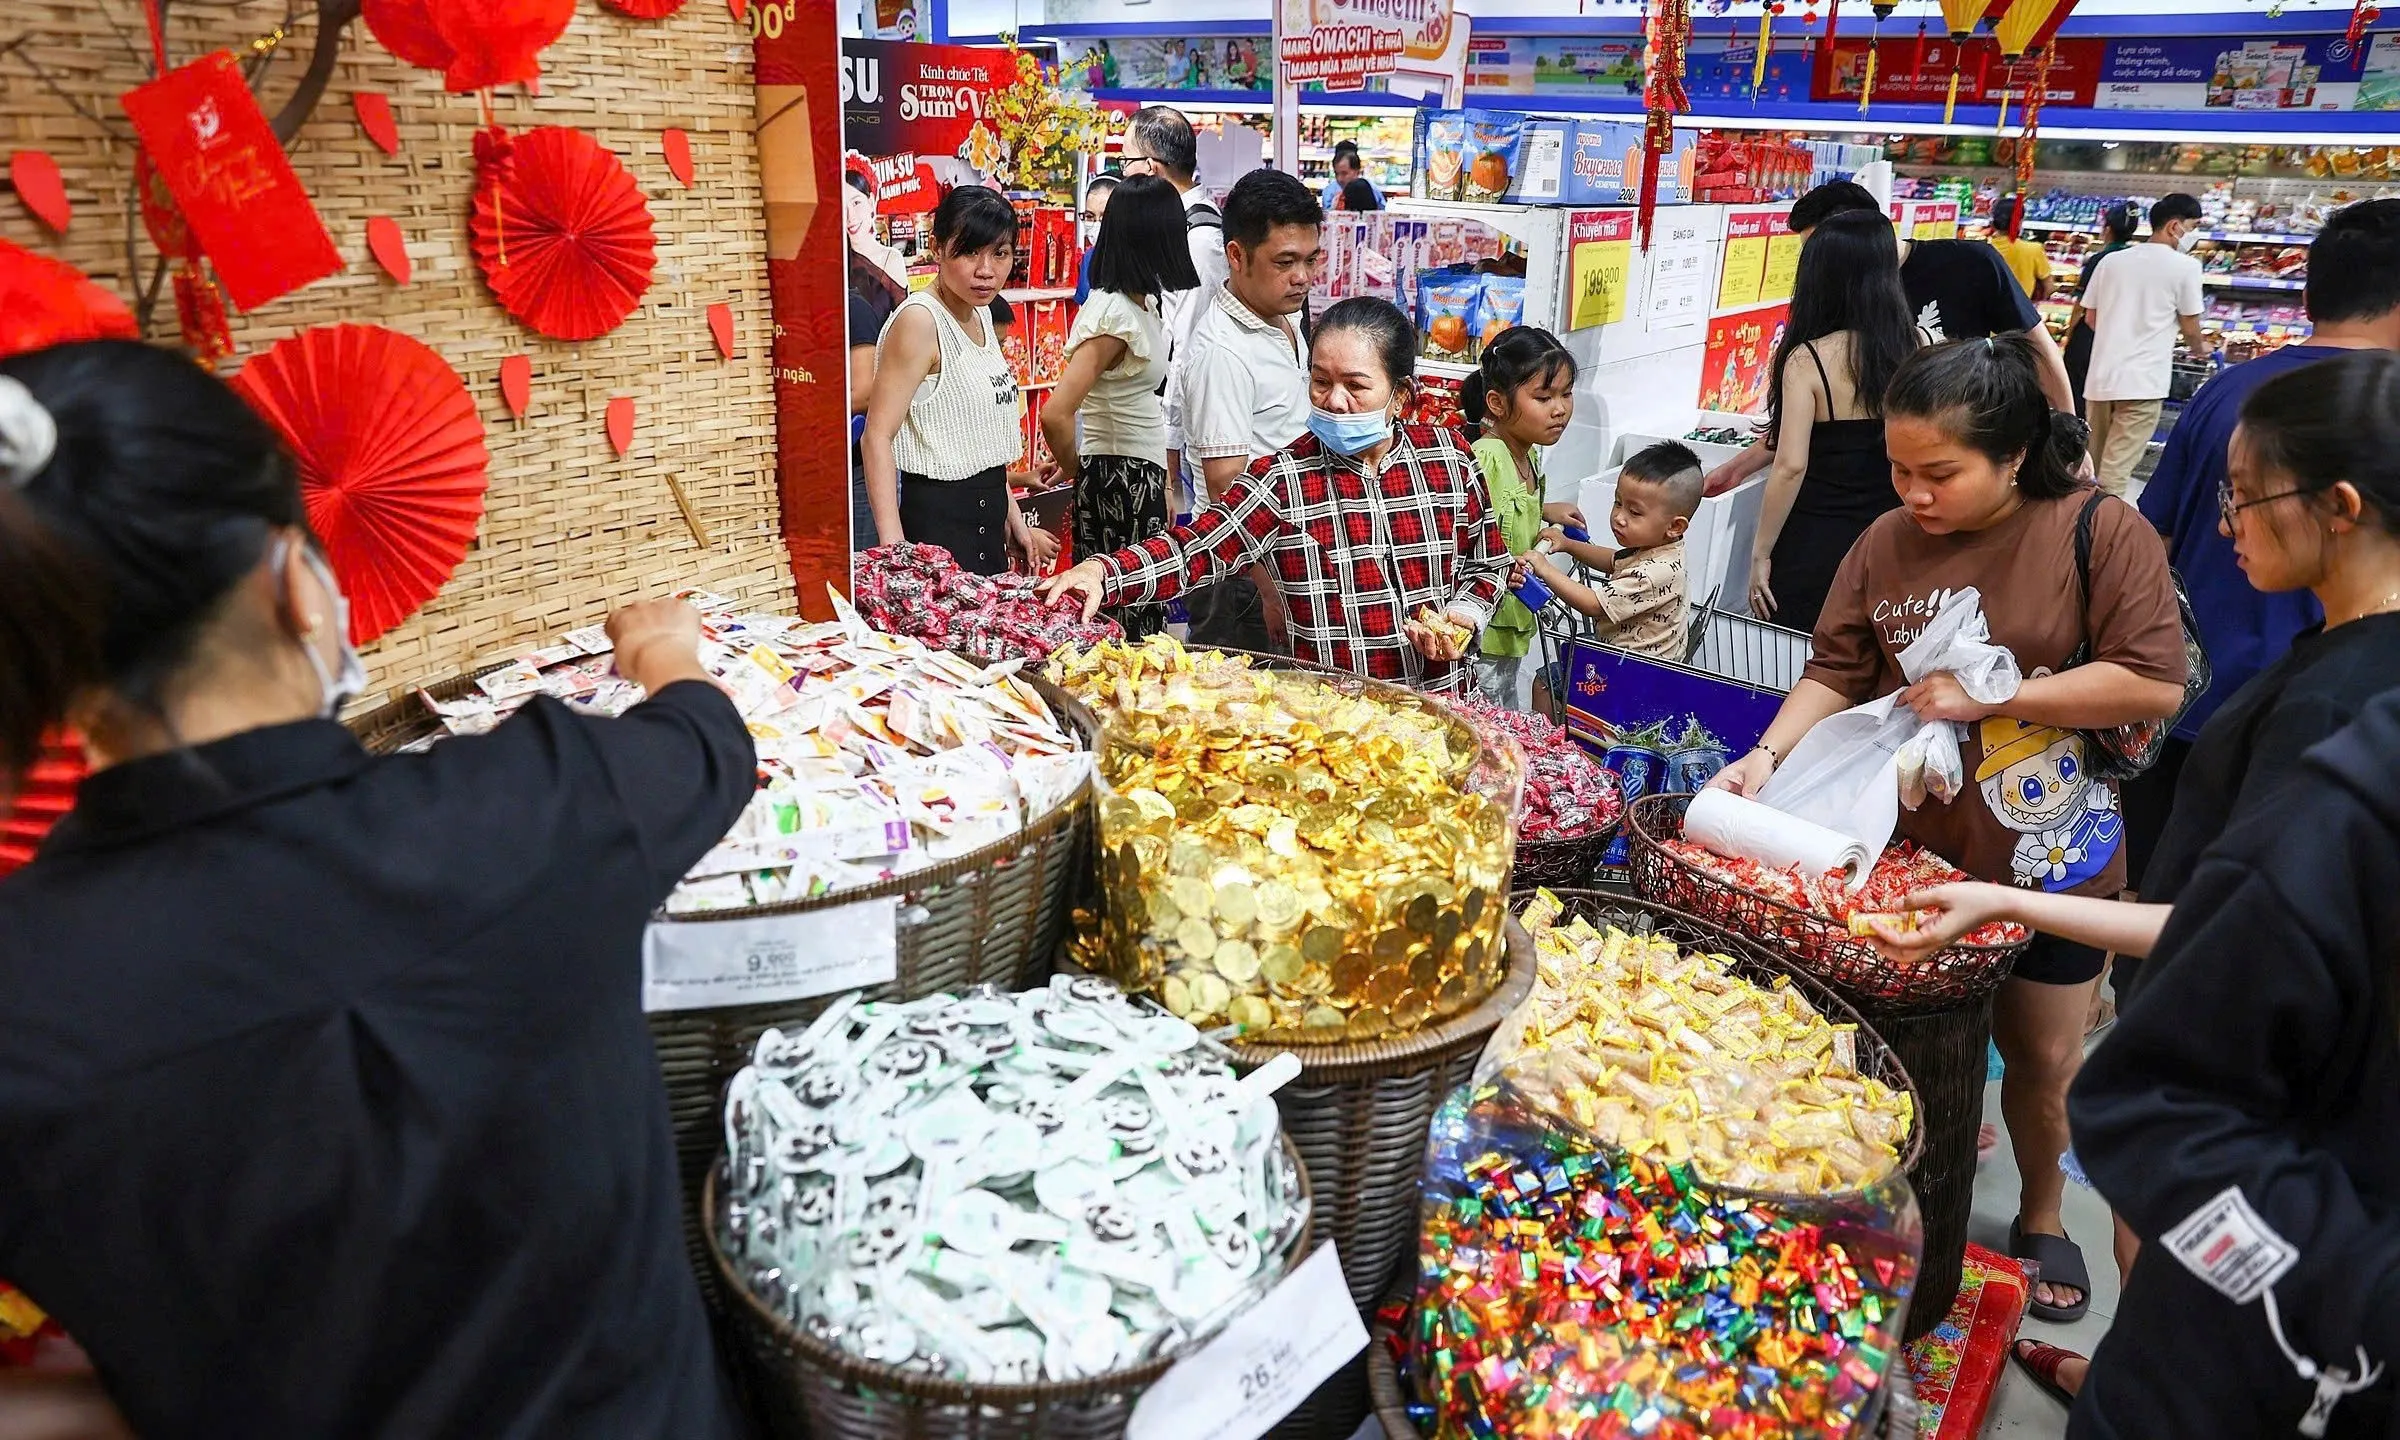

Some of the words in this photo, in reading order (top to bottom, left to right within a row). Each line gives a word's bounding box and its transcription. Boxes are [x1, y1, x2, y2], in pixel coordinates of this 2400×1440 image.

[1282, 38, 1311, 58] MANG
[919, 64, 945, 80] Kính
[946, 65, 971, 82] chúc
[971, 66, 990, 83] Tết
[1290, 61, 1319, 78] MANG
[919, 84, 954, 101] TRỌN
[900, 84, 957, 121] Sum
[1574, 150, 1622, 185] Вкусные
[901, 175, 922, 194] PHÚC
[1675, 187, 1689, 199] 200
[1618, 188, 1636, 201] 200
[783, 366, 817, 385] ngân.
[1576, 681, 1608, 696] Tiger
